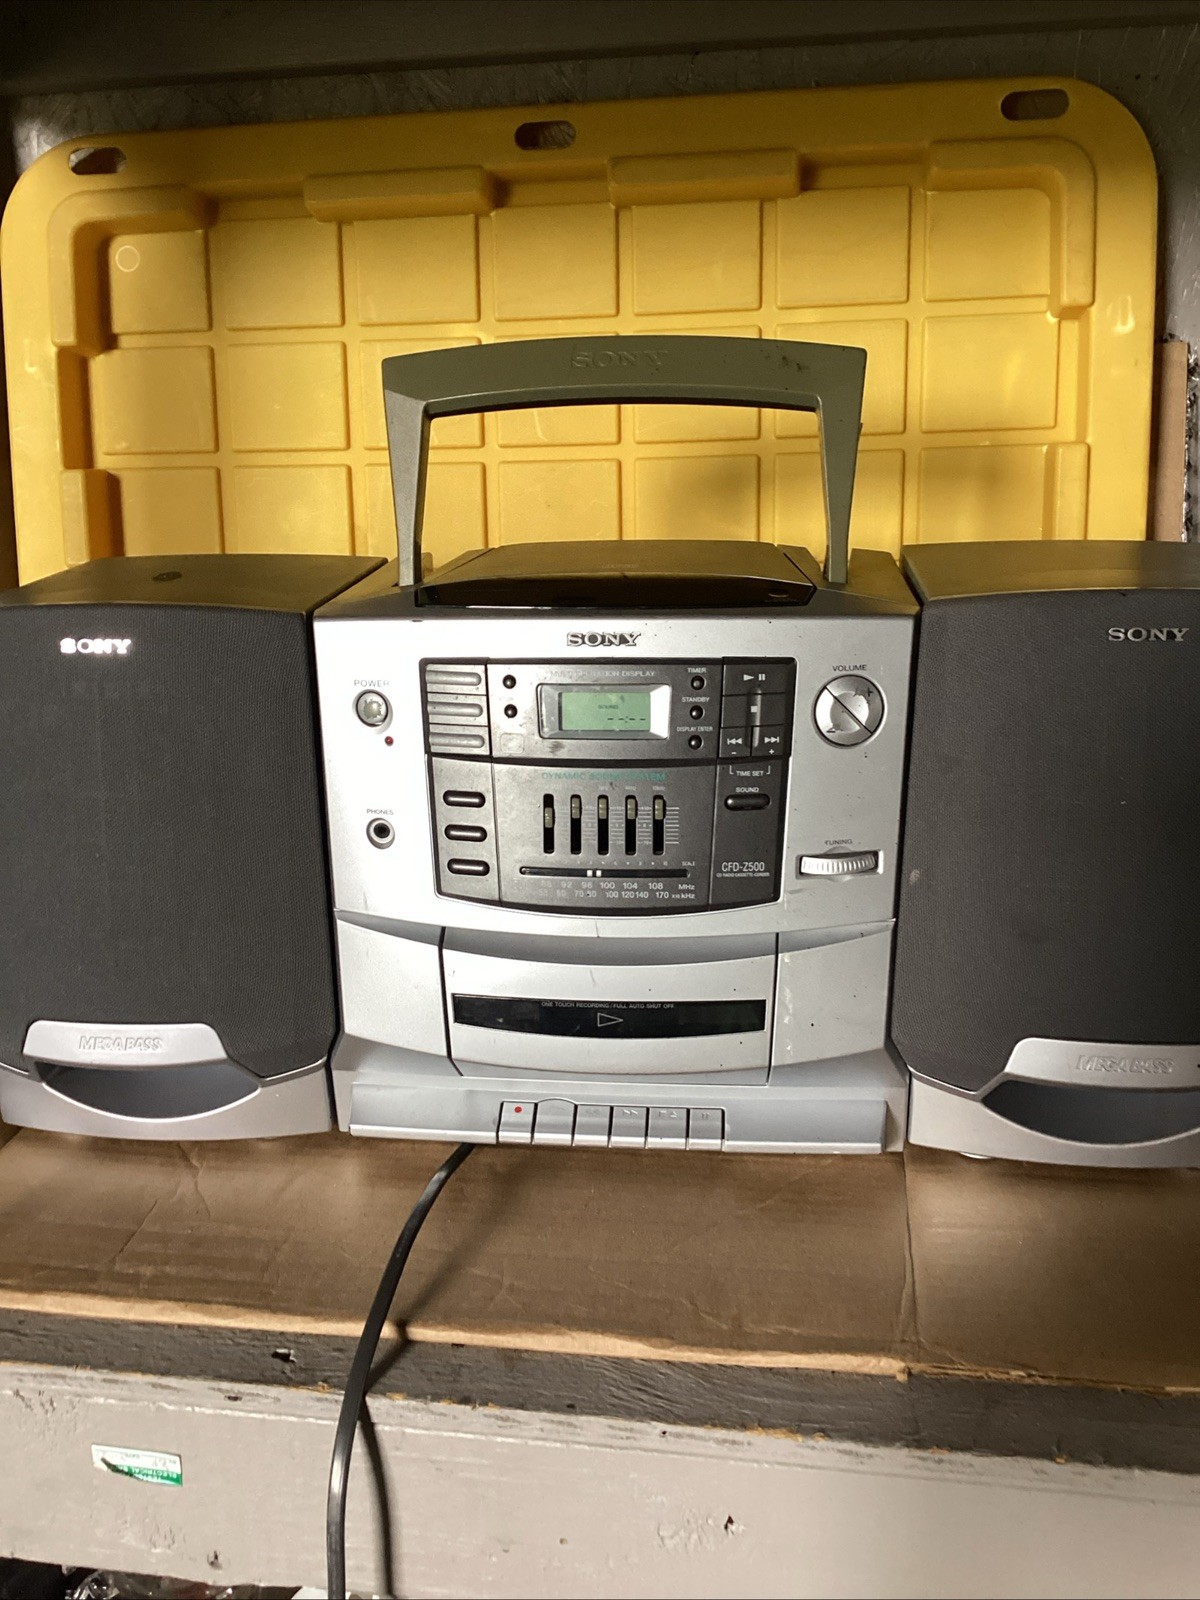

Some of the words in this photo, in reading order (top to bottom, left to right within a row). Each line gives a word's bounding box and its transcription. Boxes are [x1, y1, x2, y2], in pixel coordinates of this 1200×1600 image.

[571, 351, 667, 368] SONY
[566, 631, 641, 647] SONY
[1108, 627, 1190, 642] SONY
[60, 637, 131, 654] SONY
[832, 664, 868, 672] VOLUME
[353, 679, 390, 687] POWER
[541, 772, 585, 780] DYNAMIC
[721, 861, 765, 872] CFD-Z500
[600, 881, 615, 889] 100
[648, 882, 664, 890] 108
[606, 890, 619, 898] 100
[621, 891, 635, 899] 120
[635, 891, 649, 899] 140
[656, 891, 669, 899] 170
[79, 1036, 124, 1051] MEGA
[124, 1037, 164, 1051] BASS
[1076, 1054, 1129, 1073] MEGA
[1129, 1056, 1175, 1074] BASS
